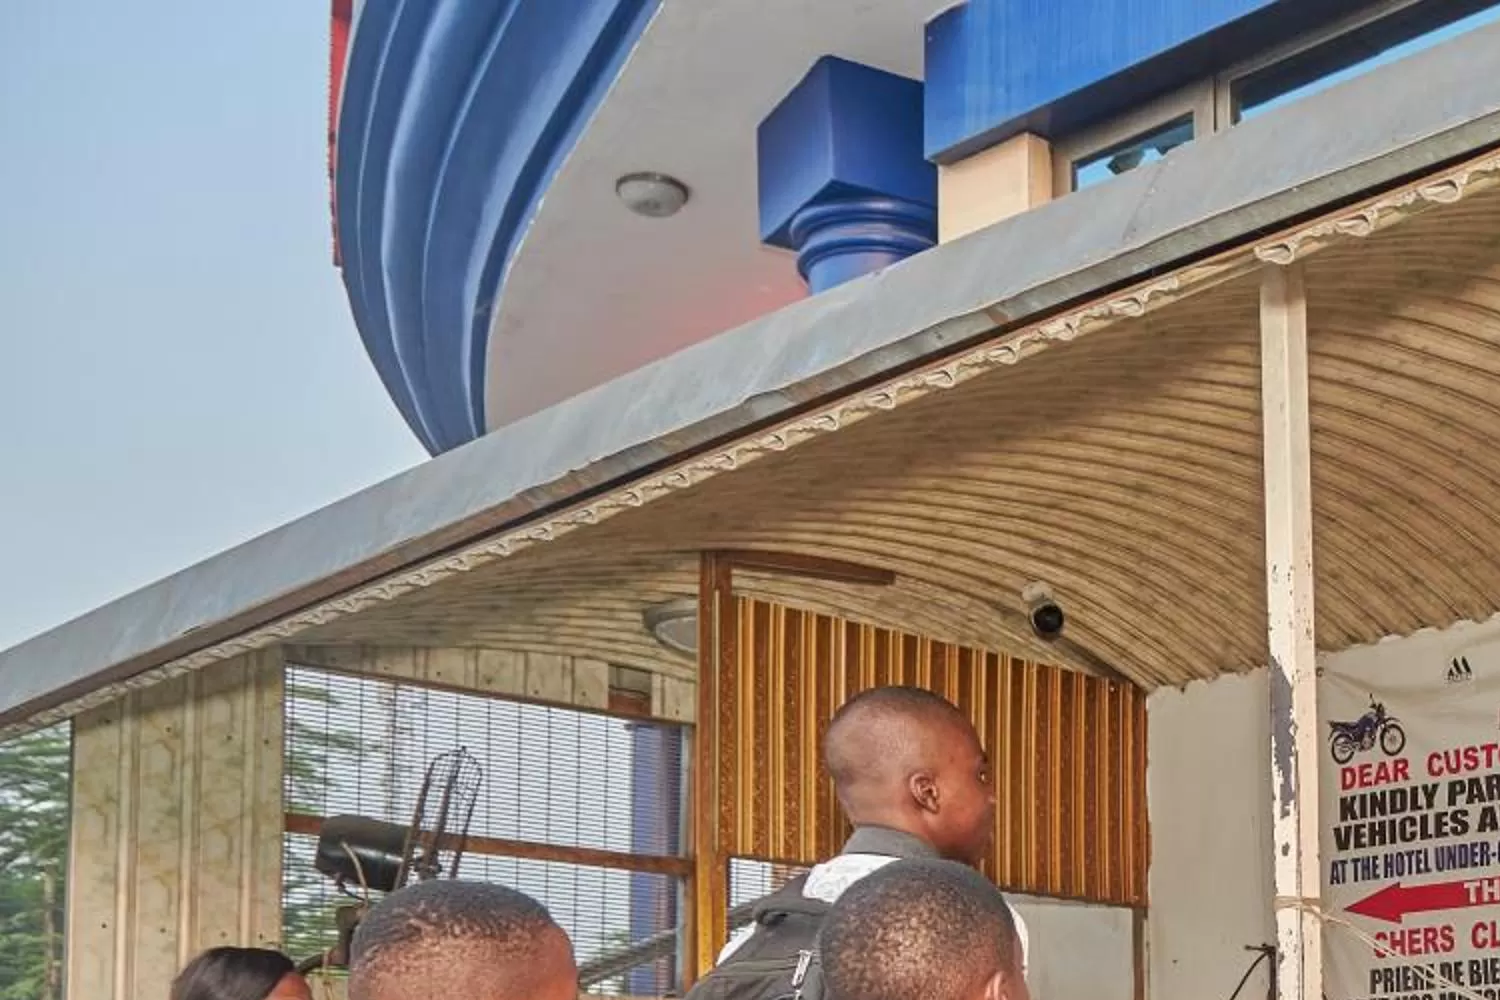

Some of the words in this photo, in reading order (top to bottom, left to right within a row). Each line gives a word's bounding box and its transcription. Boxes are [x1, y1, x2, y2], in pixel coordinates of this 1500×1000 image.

[1341, 757, 1410, 790] DEAR
[1339, 783, 1440, 822] KINDLY
[1333, 809, 1470, 851] VEHICLES
[1330, 860, 1348, 885] AT
[1351, 855, 1380, 882] THE
[1384, 848, 1431, 879] HOTEL
[1373, 925, 1455, 958] CHERS
[1440, 961, 1464, 989] DE
